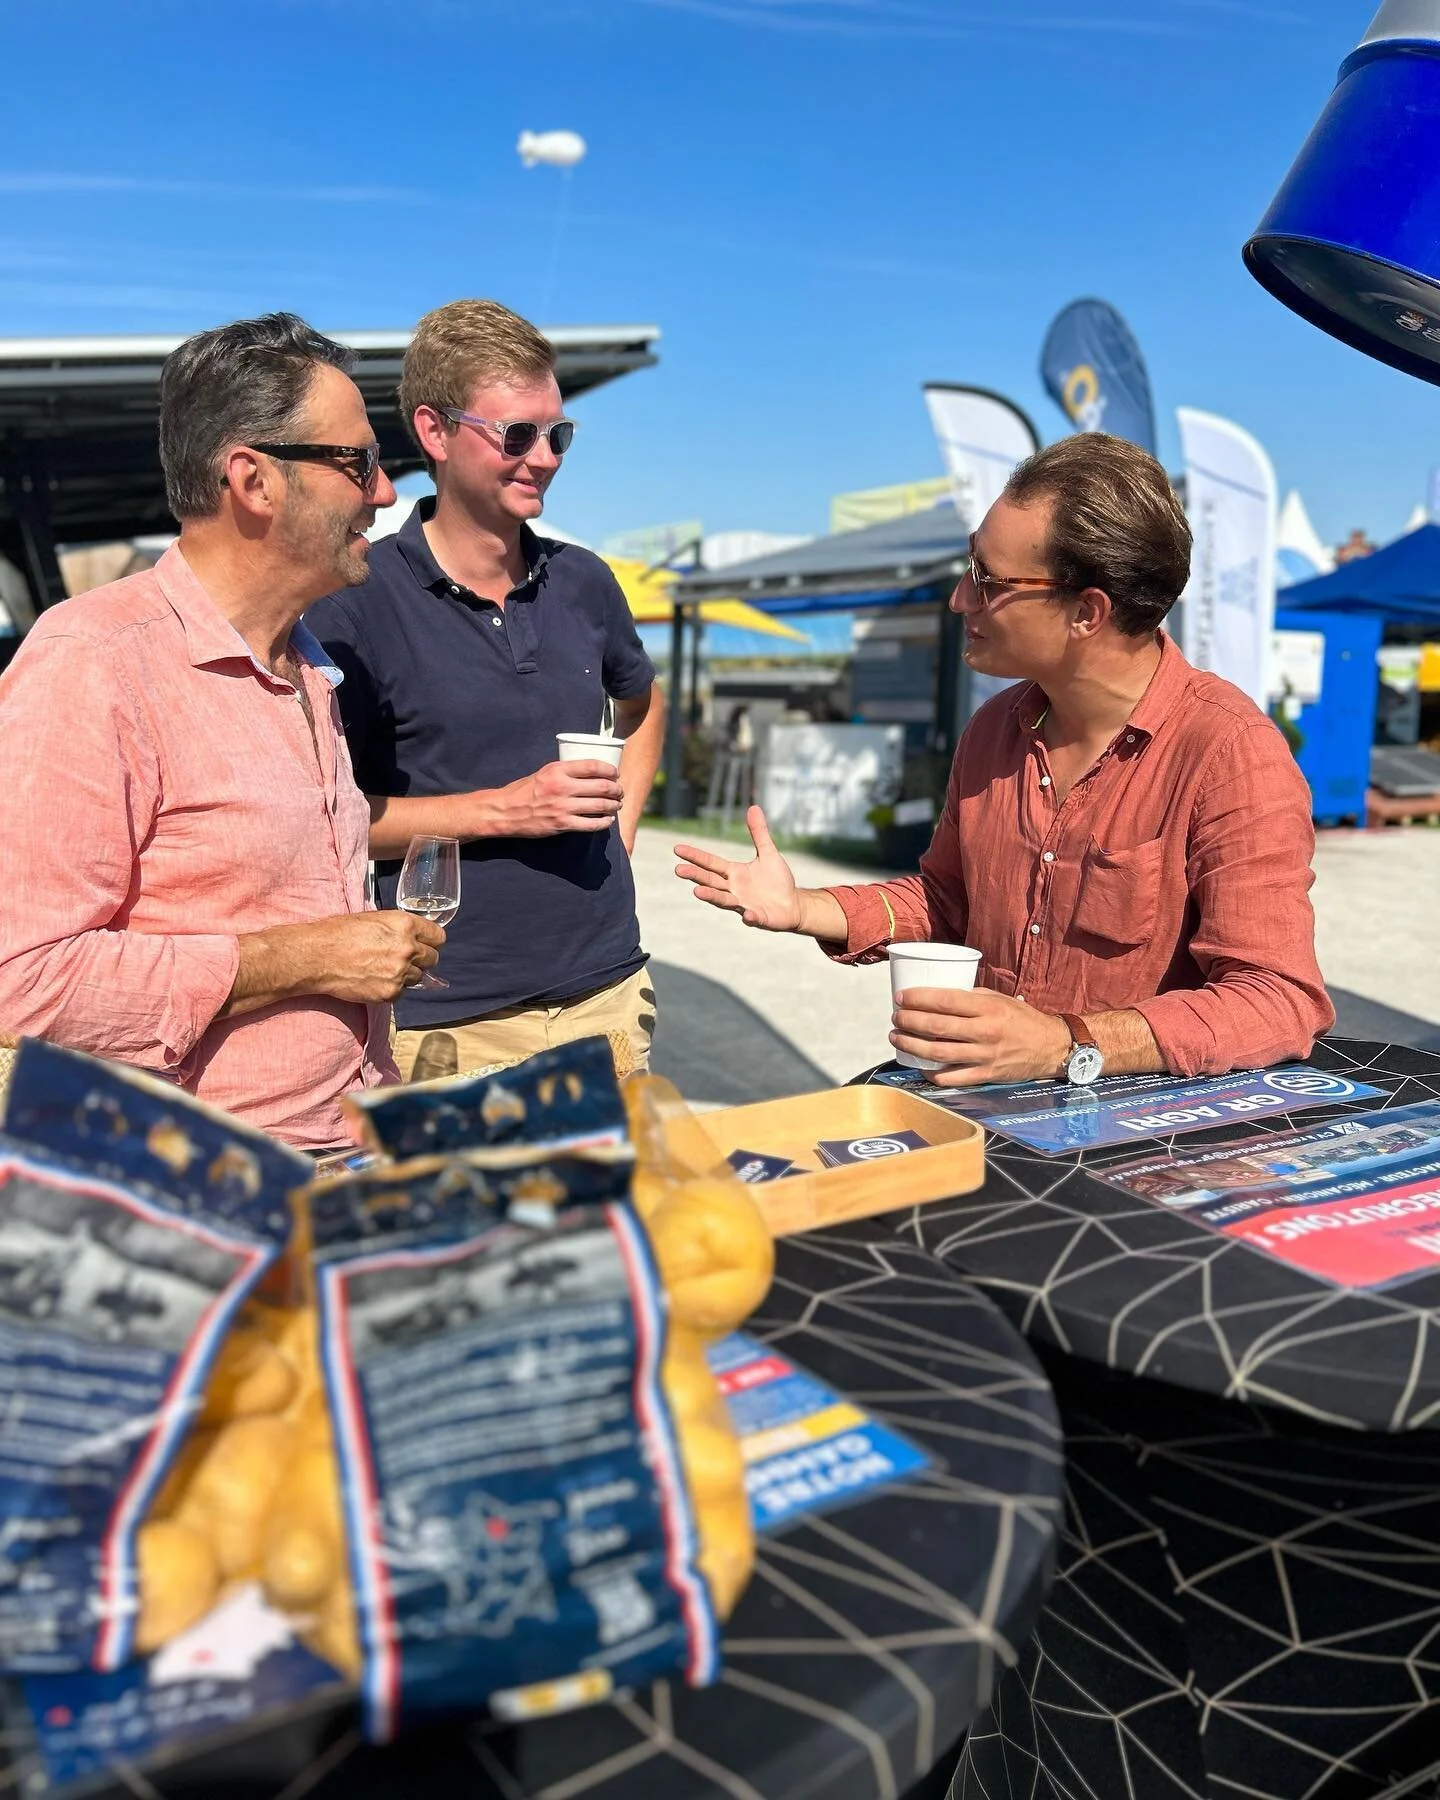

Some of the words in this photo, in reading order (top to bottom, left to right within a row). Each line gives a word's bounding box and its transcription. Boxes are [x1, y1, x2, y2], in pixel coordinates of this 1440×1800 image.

[1182, 1079, 1258, 1096] PRODUCTEUR
[1217, 1094, 1285, 1112] GR
[996, 1107, 1099, 1126] CONDITIONNEUR
[1116, 1106, 1222, 1131] AGRI
[1281, 1180, 1374, 1203] MÉCANICIEN
[1201, 1198, 1273, 1221] CARISTE
